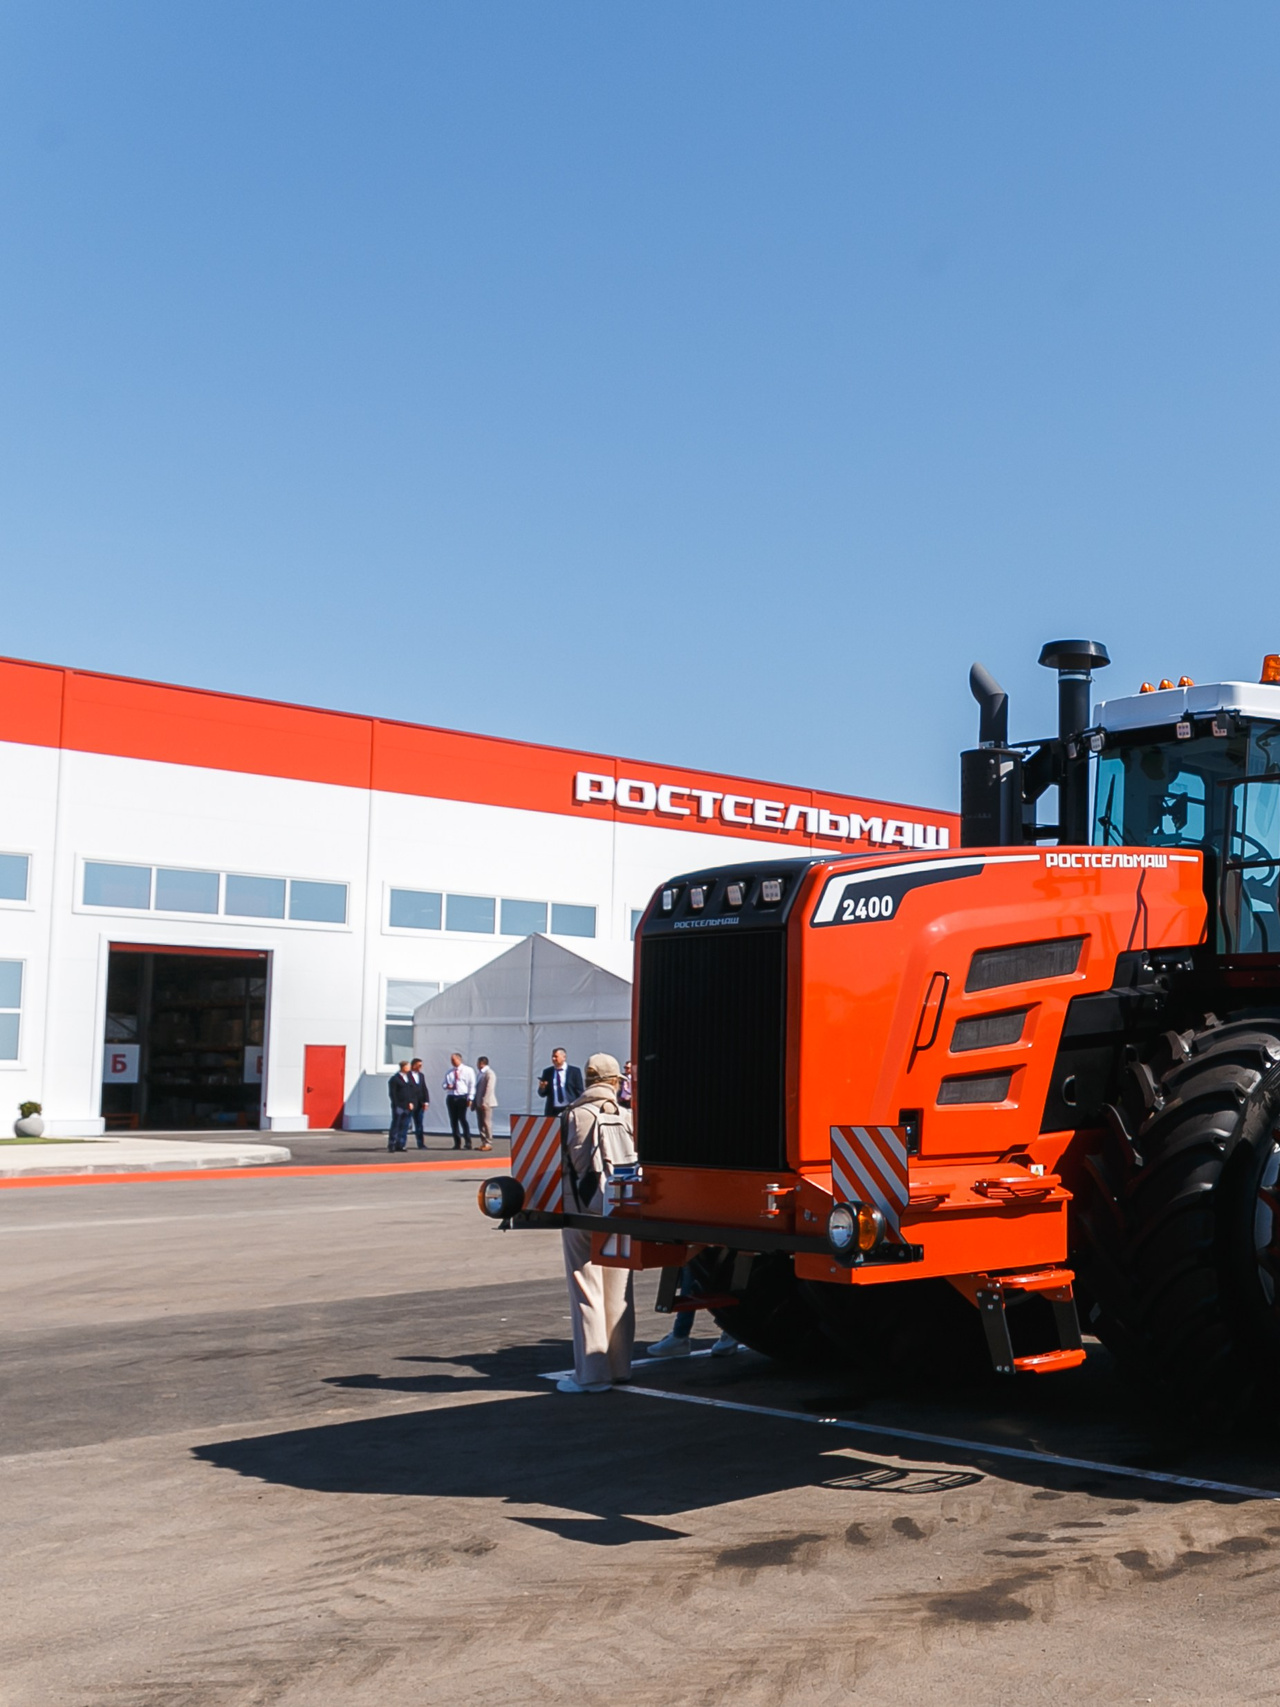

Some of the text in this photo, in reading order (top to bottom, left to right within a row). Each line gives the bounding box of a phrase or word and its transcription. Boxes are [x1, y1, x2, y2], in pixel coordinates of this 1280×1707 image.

[575, 771, 949, 850] РОСТСЕЛЬМАШ
[1045, 853, 1168, 869] РОСТСЕЛЬМАШ
[842, 895, 893, 921] 2400
[673, 916, 739, 930] РОСТСЕЛЬМАШ
[111, 1053, 127, 1074] Б
